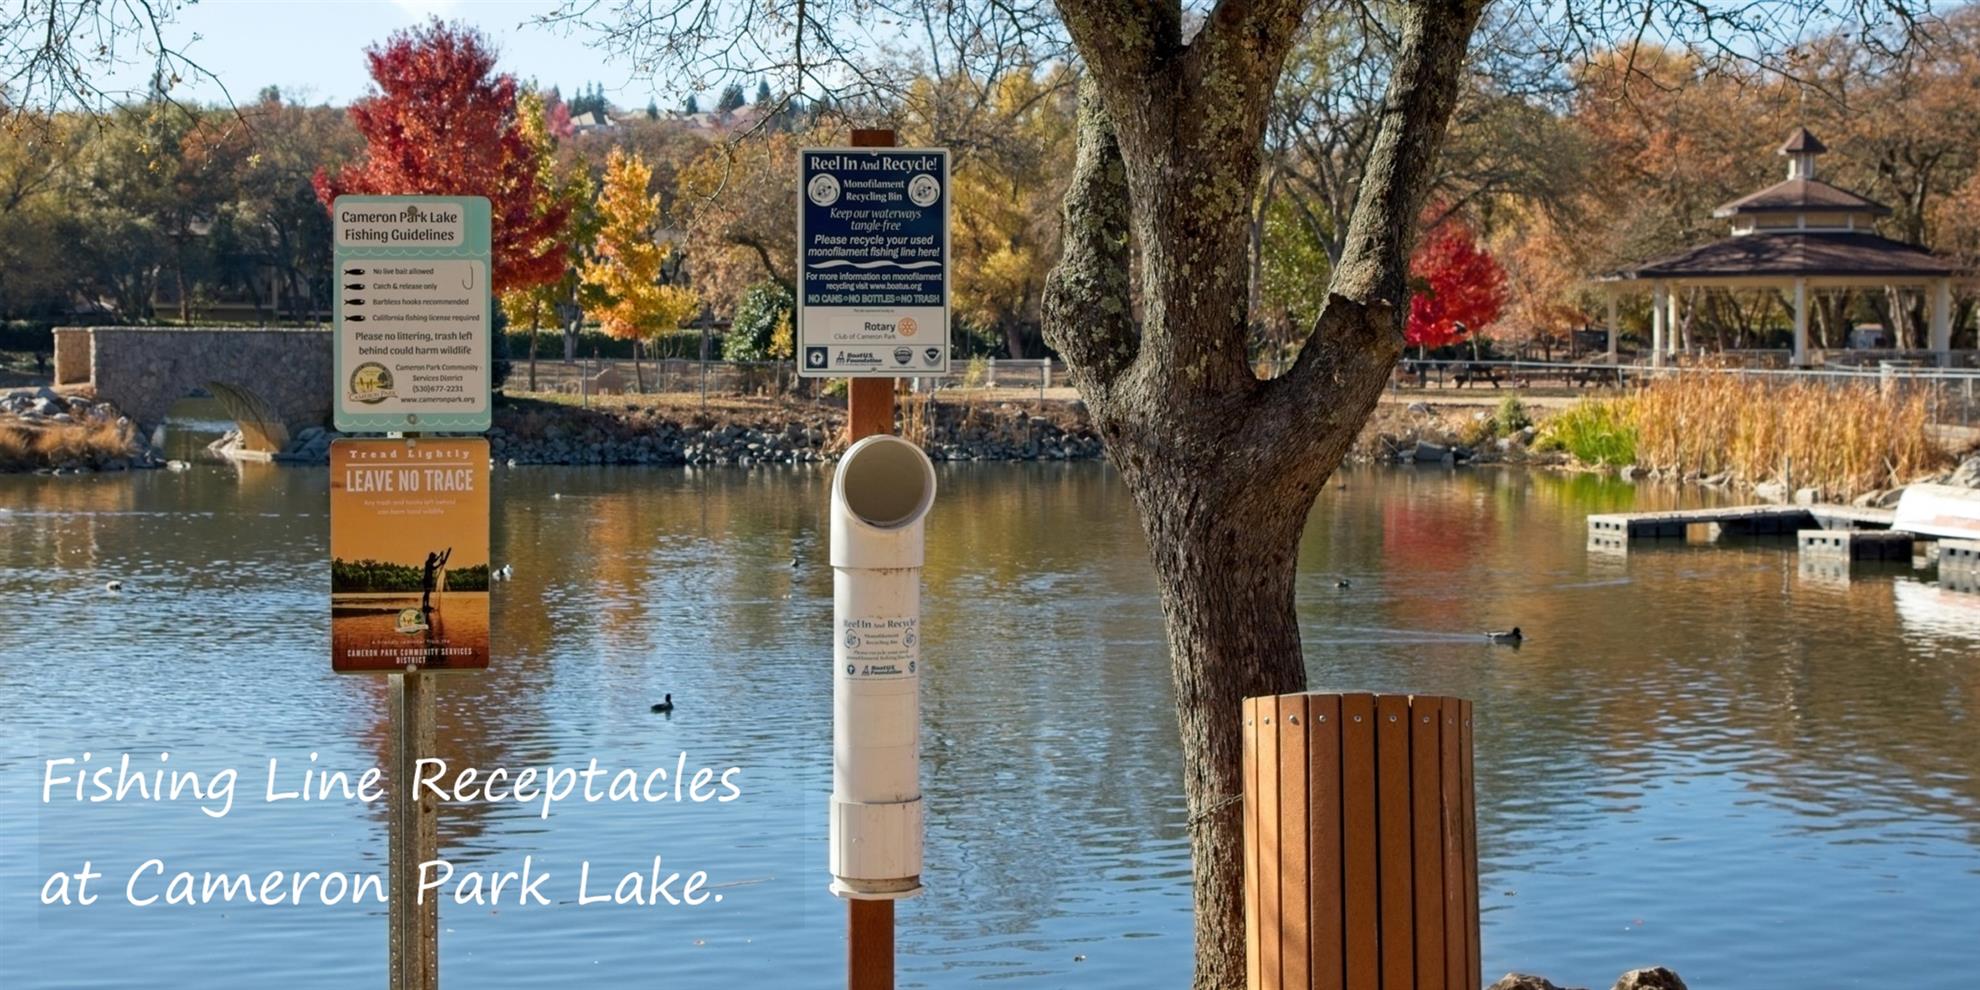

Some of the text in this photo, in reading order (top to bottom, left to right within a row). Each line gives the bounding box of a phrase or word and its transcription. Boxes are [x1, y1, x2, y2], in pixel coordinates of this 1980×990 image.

[811, 156, 937, 174] Reel In And Recycle!
[843, 179, 905, 188] Monofilament
[846, 192, 903, 203] Recycling Bin
[341, 211, 457, 223] Cameron Park Lake
[830, 208, 922, 222] Keep our waterways
[850, 219, 901, 233] tangle-free
[345, 228, 455, 243] Fishing Guidelines
[814, 234, 934, 247] Please recycle your used
[808, 247, 940, 259] monofilament fishing line here!
[408, 267, 434, 275] allowed
[806, 272, 818, 281] For
[839, 272, 881, 281] information
[892, 272, 942, 281] monofilament
[423, 283, 438, 291] only
[826, 282, 922, 291] recycling visit www.boatus.org
[372, 298, 469, 306] Barbless hooks recommended
[808, 294, 820, 303] NO
[848, 294, 859, 303] NO
[862, 294, 895, 303] BOTTLES
[900, 294, 912, 303] NO
[914, 294, 940, 303] TRASH
[372, 314, 480, 323] California fishing license required
[864, 322, 896, 333] Rotary
[355, 332, 384, 341] Please
[397, 331, 433, 342] littering,
[435, 332, 457, 341] trash
[459, 331, 473, 341] left
[359, 346, 472, 355] behind could harm wildlife
[395, 364, 426, 372] Cameron
[426, 364, 440, 372] Park
[441, 364, 478, 373] Community
[400, 395, 475, 404] www.cameronpark.org
[350, 449, 470, 460] Tread Lightly
[346, 469, 474, 492] LEAVE NO TRACE
[862, 620, 872, 628] In
[440, 648, 472, 656] SERVICES
[396, 656, 426, 664] DISTRICT
